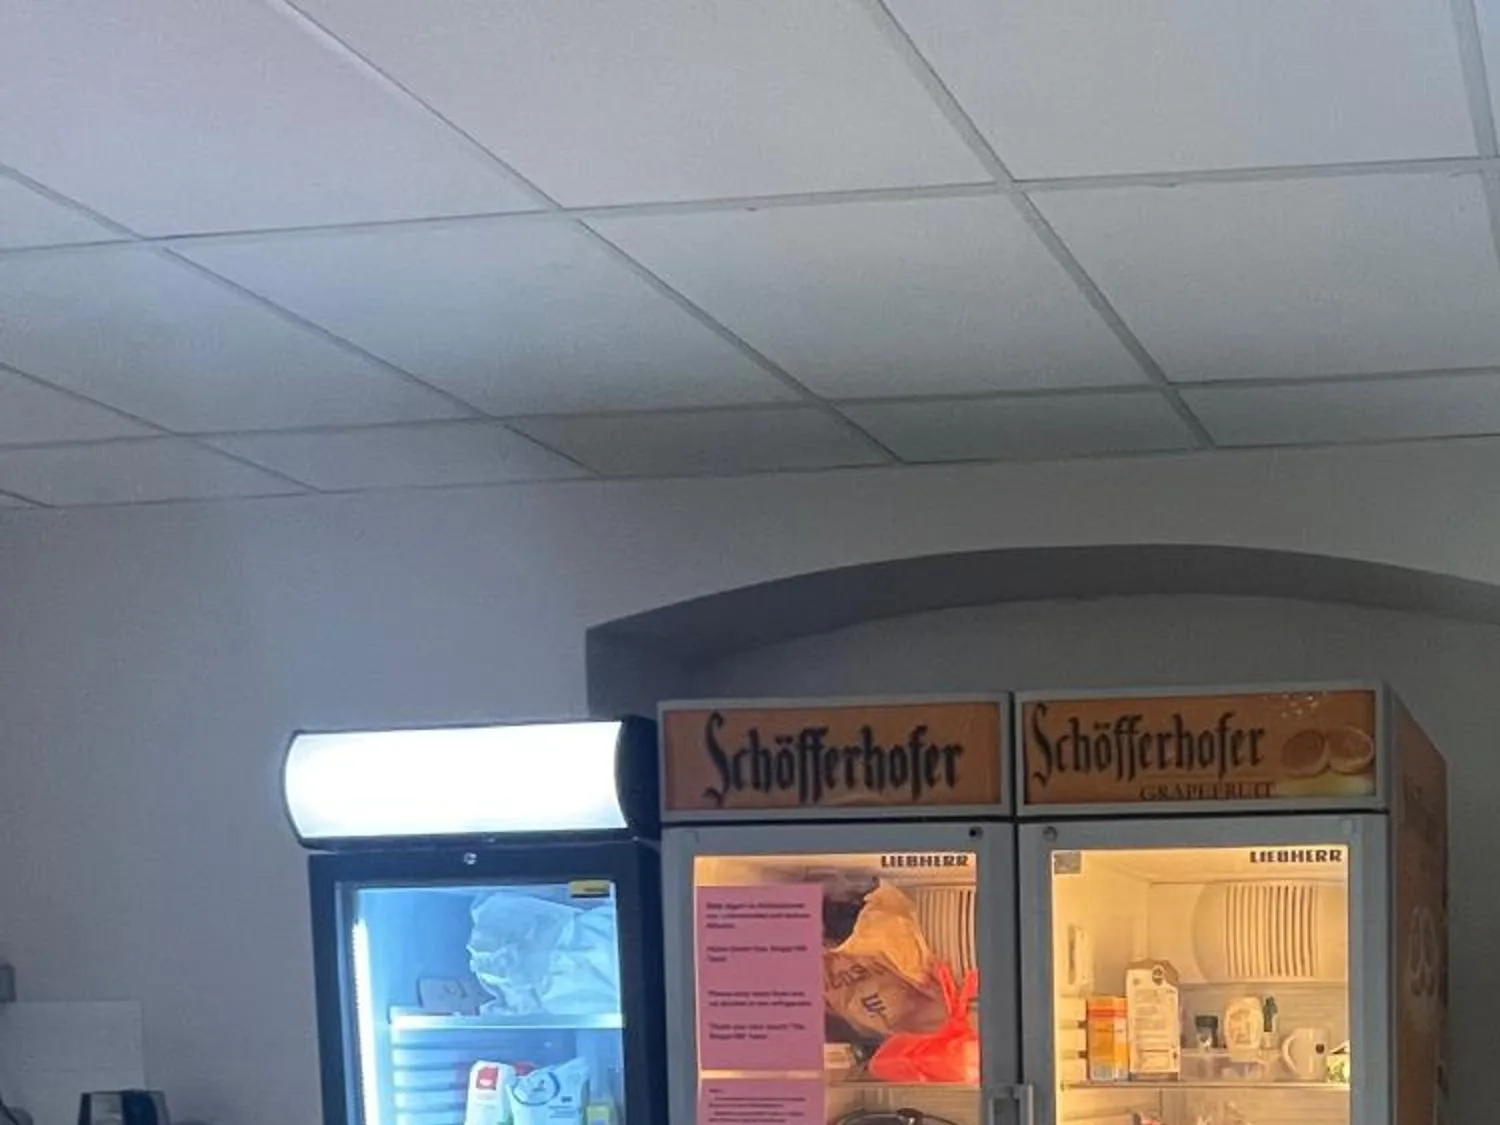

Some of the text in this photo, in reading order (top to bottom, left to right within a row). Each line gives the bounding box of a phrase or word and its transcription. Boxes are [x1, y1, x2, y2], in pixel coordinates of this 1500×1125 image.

[1032, 703, 1266, 787] Schöfferhofer
[703, 710, 964, 806] Schöfferhofer
[1140, 781, 1275, 801] GRAPEFRUIT
[881, 855, 969, 868] LIEBHERR
[1250, 849, 1343, 863] LIEBHERR
